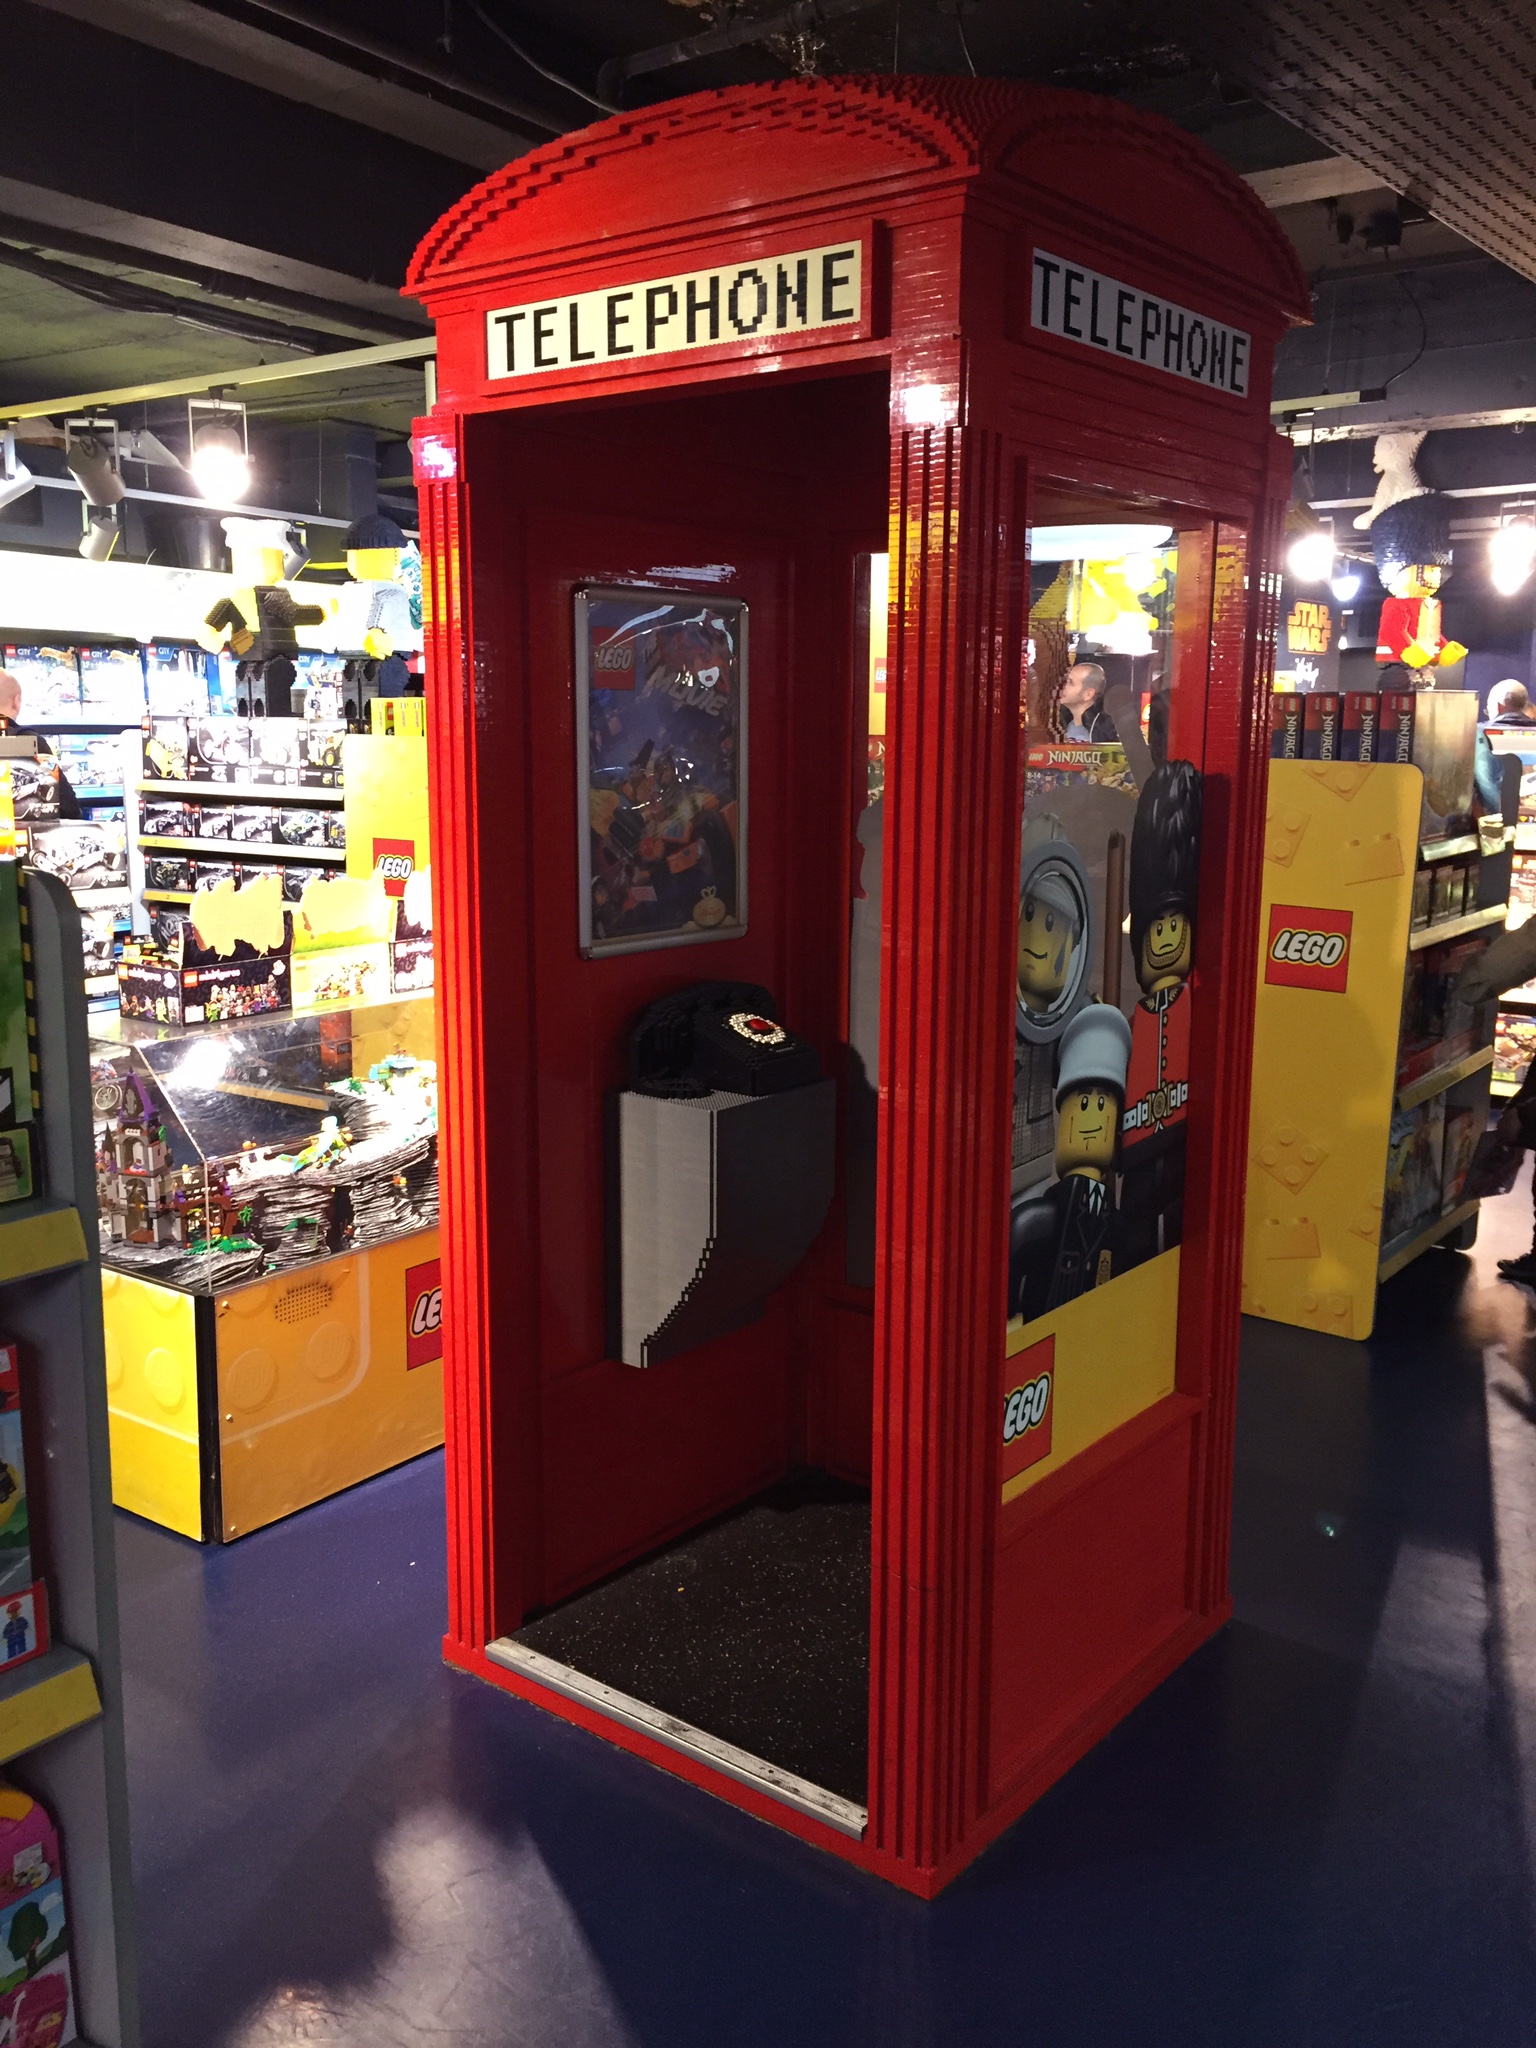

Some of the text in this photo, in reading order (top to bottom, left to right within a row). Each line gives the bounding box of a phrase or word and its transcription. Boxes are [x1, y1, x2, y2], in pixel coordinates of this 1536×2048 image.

[495, 249, 855, 372] TELEPHONE
[1034, 256, 1248, 393] TELEPHONE
[1287, 601, 1332, 629] STAR
[17, 647, 31, 656] CITY
[91, 650, 103, 658] CITY
[158, 647, 170, 655] CITY
[1287, 625, 1332, 653] WARS
[596, 646, 633, 671] LEGO
[645, 665, 729, 716] MOVIE
[1360, 714, 1374, 762] NINJAGO
[1397, 714, 1411, 763] NINJAGO
[1026, 771, 1041, 779] 8-14
[1046, 751, 1103, 767] NINJAGO
[1273, 930, 1345, 966] LEGO
[411, 1289, 443, 1336] LE
[1003, 1374, 1050, 1443] EGO
